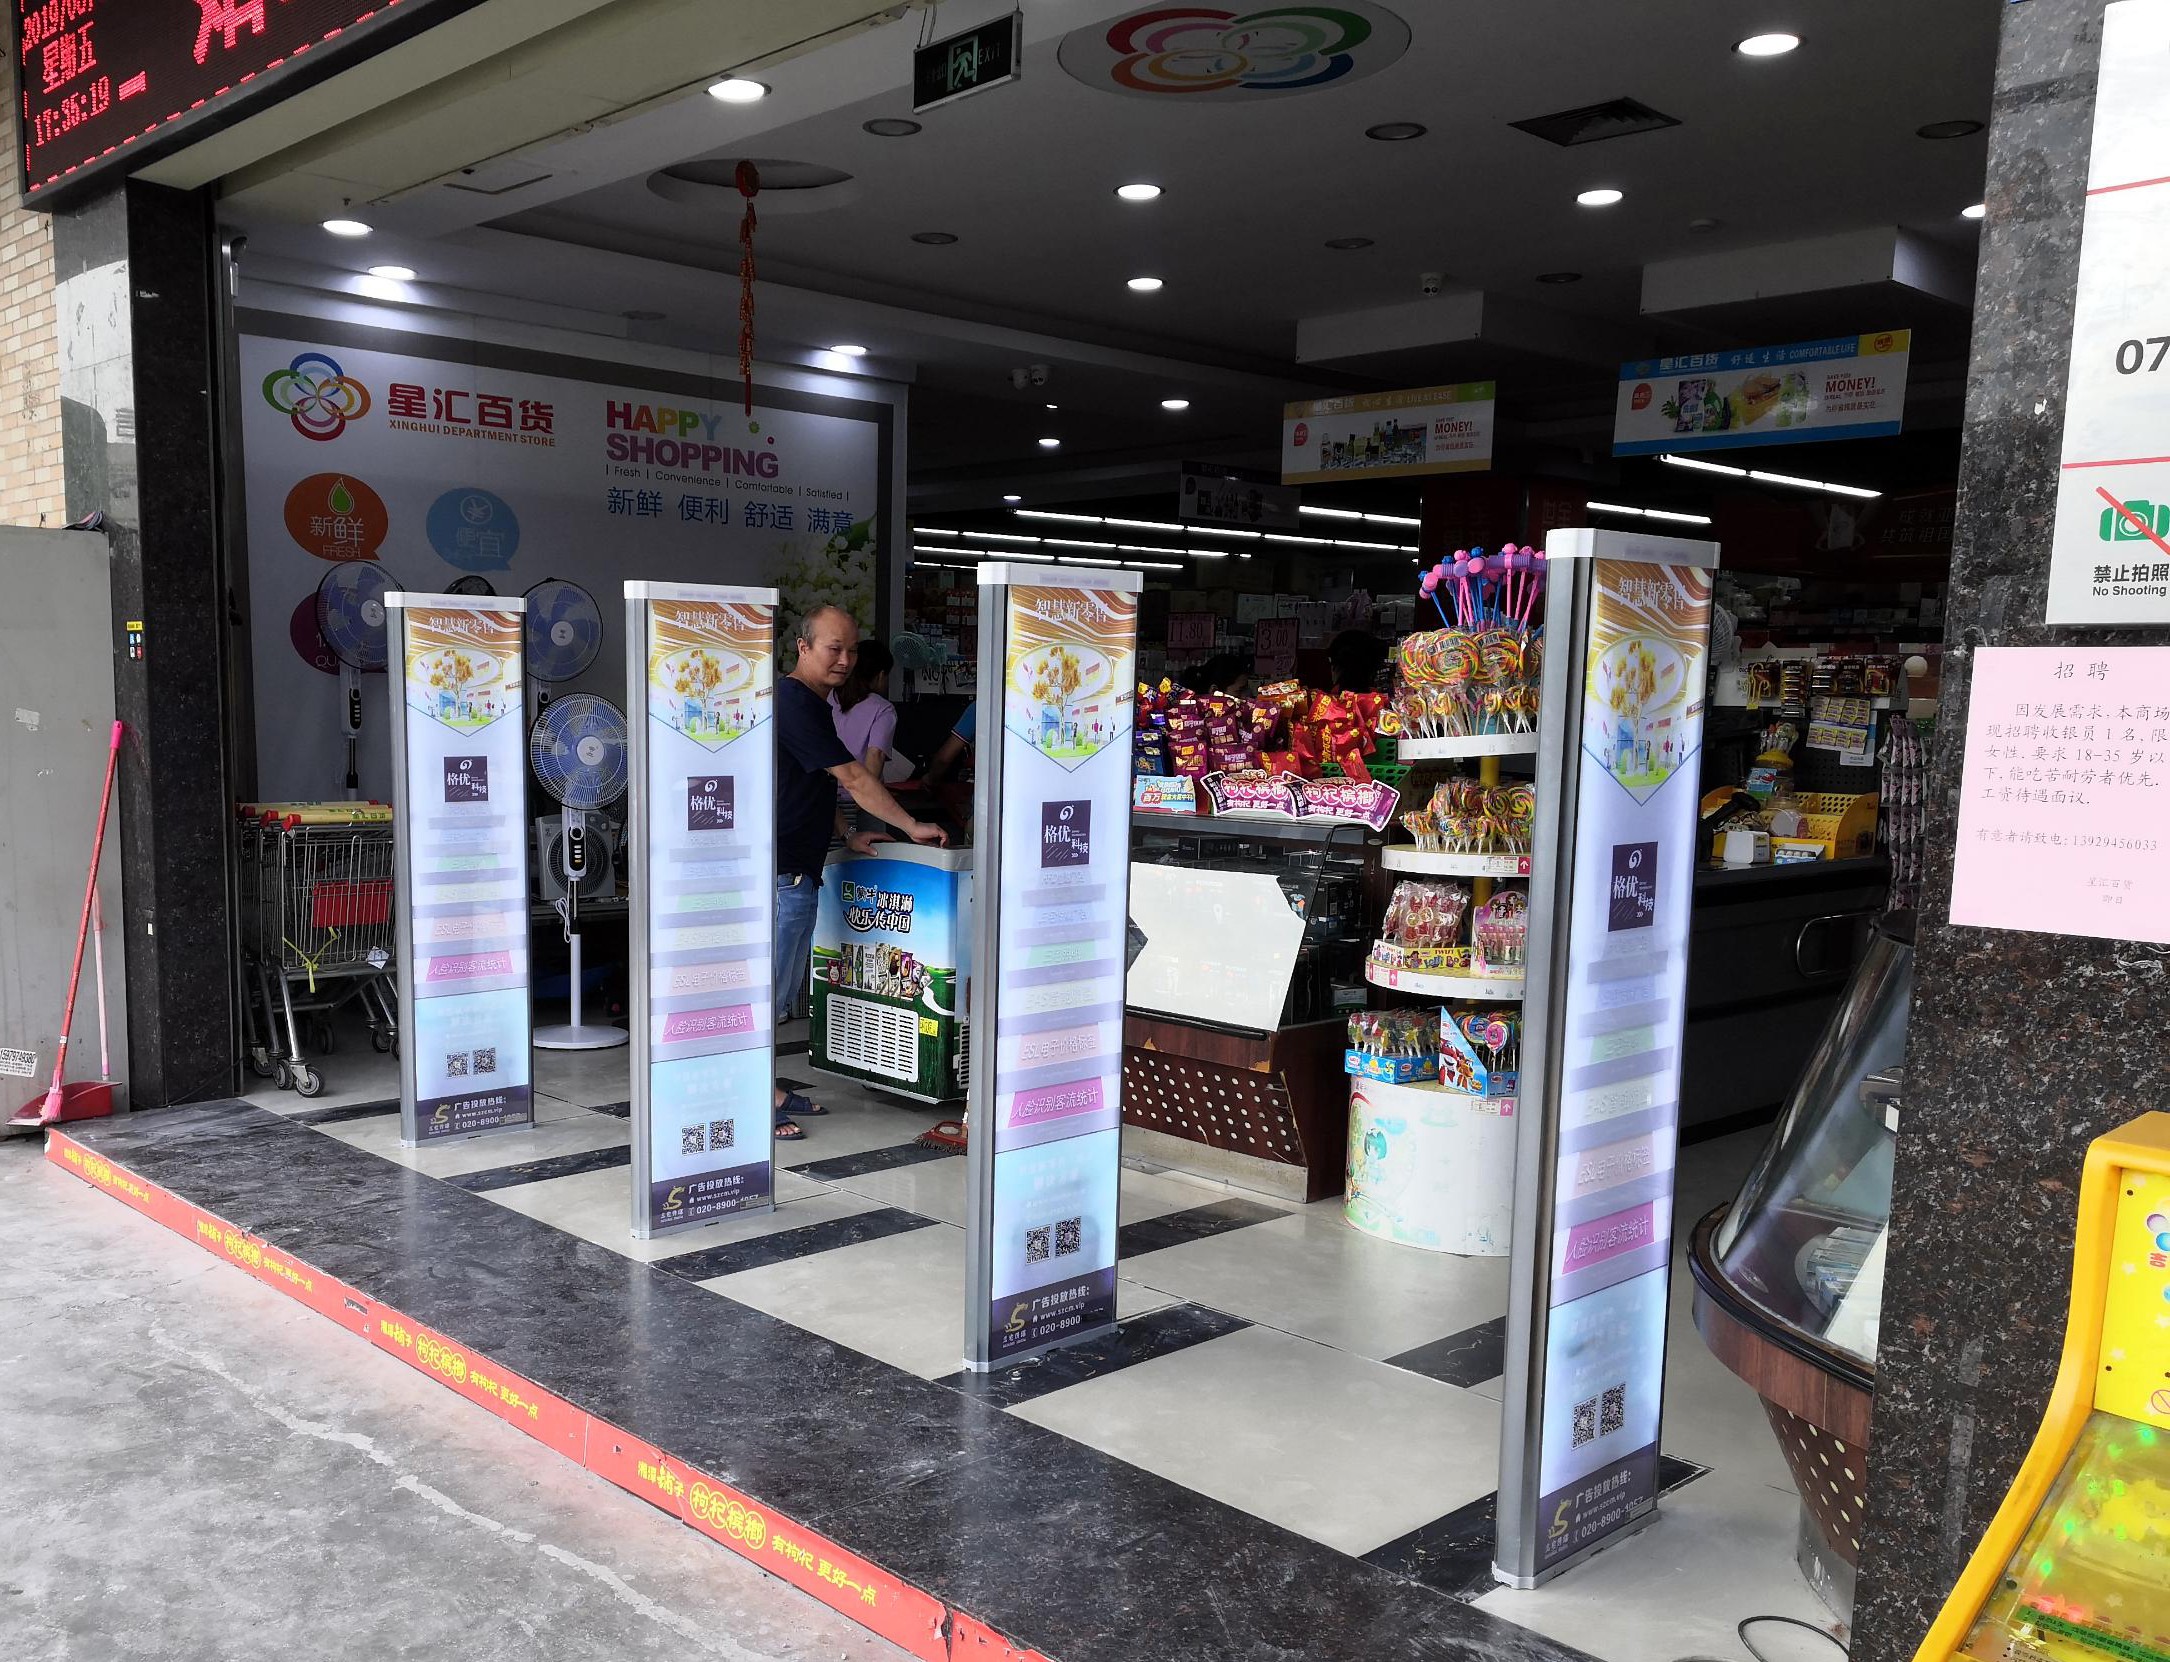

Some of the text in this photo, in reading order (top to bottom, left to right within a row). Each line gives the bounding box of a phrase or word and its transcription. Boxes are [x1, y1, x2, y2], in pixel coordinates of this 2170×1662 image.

[43, 21, 97, 94] 星期五
[978, 41, 1001, 65] EXIT
[1825, 377, 1876, 393] MONEY!
[387, 382, 555, 434] 星汇百货
[606, 400, 722, 441] HAPPY
[389, 420, 556, 447] XINGHUI DEPARTMENT STORE
[1434, 421, 1473, 434] MONEY!
[606, 433, 779, 478] SHOPPING
[614, 466, 641, 478] Fresh
[655, 470, 721, 486] Convenience
[735, 479, 794, 495] Comfortable
[607, 487, 854, 534] 新鲜 便利 舒适 满意
[309, 515, 365, 548] 新鲜
[2093, 563, 2170, 583] 禁止拍照
[2093, 585, 2167, 597] No Shooting
[1035, 597, 1108, 623] 智慧新零售
[2053, 661, 2110, 681] 招聘
[446, 772, 471, 788] 格优
[690, 795, 717, 812] 格优
[1305, 785, 1374, 806] 枸杞槟榔
[1044, 824, 1089, 854] 格优 科技
[877, 891, 913, 912] 冰淇淋
[1612, 875, 1654, 912] 格优 科技
[848, 906, 911, 932] 快乐传中国
[1013, 1087, 1100, 1120] 人脸识别客流统计
[688, 1174, 745, 1194] 广告投放热线:
[1566, 1215, 1650, 1263] 人脸识别客流统计
[1032, 1285, 1090, 1312] 广告投放热线:
[1575, 1470, 1632, 1509] 广告投放热线:
[691, 1485, 766, 1545] 枸杞槟榔
[772, 1534, 814, 1572] 有枸杞
[817, 1558, 878, 1607] 更好一点
